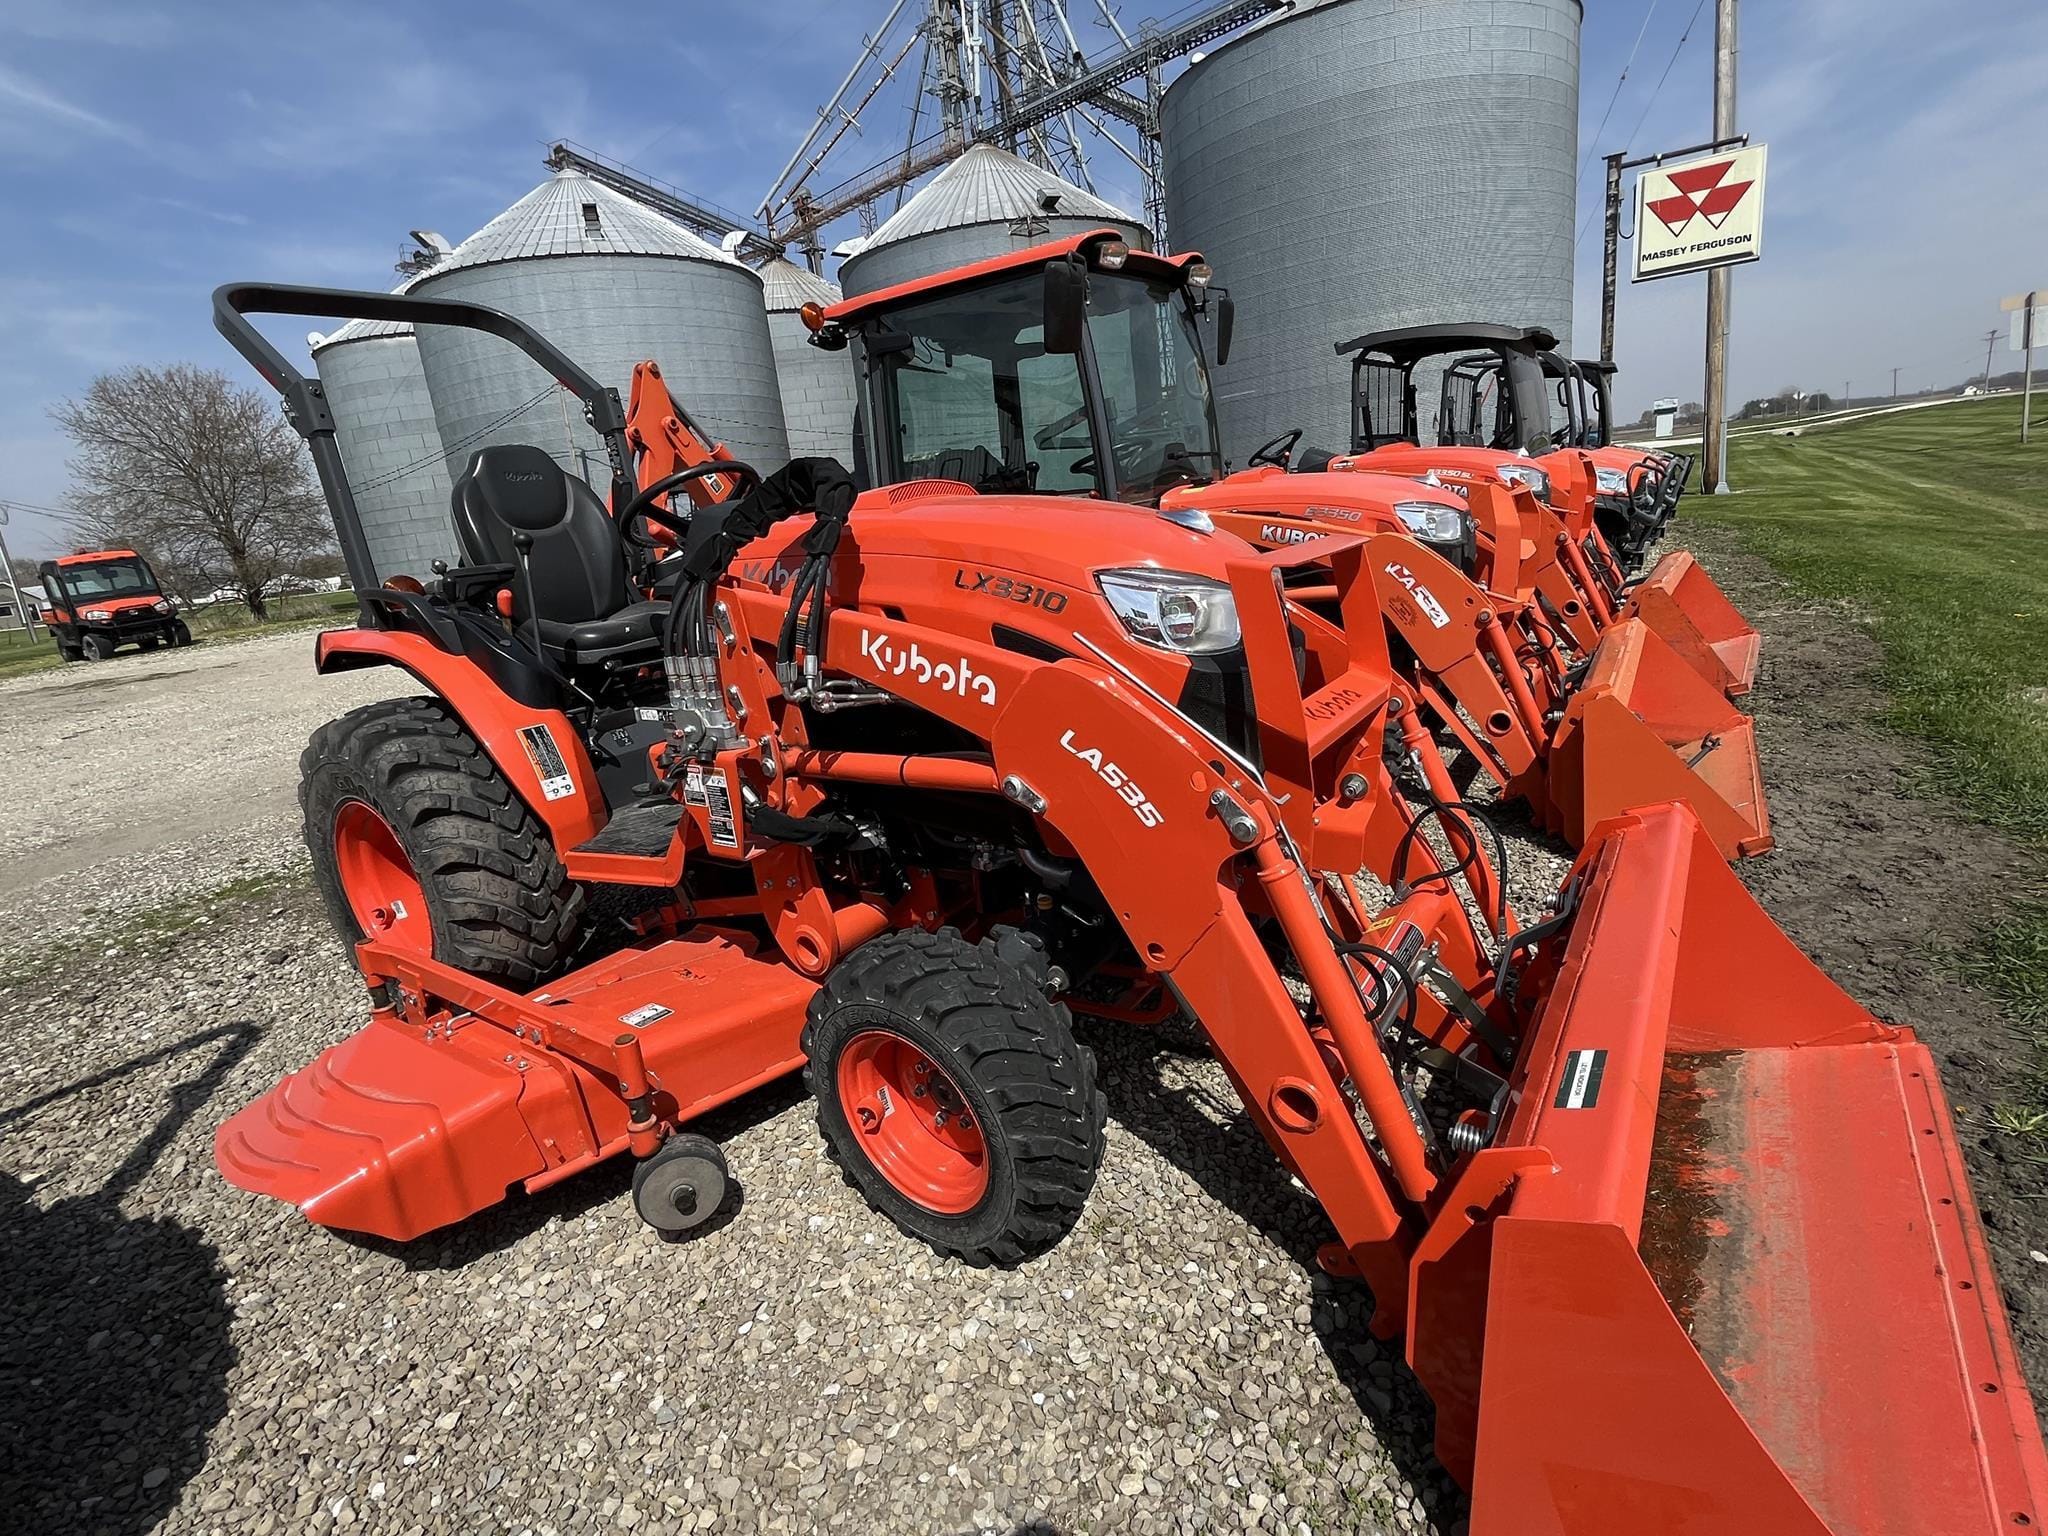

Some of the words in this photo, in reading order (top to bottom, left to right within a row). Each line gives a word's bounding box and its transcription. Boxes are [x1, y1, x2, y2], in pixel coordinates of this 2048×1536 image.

[1642, 247, 1687, 262] MASSEY
[1690, 234, 1752, 252] FERGUSON
[1441, 483, 1470, 498] OTA
[1261, 525, 1327, 545] KUBO
[954, 569, 1069, 615] LX3310
[861, 628, 997, 706] Kubota
[1303, 689, 1363, 721] Kubota
[1060, 728, 1165, 828] LA535
